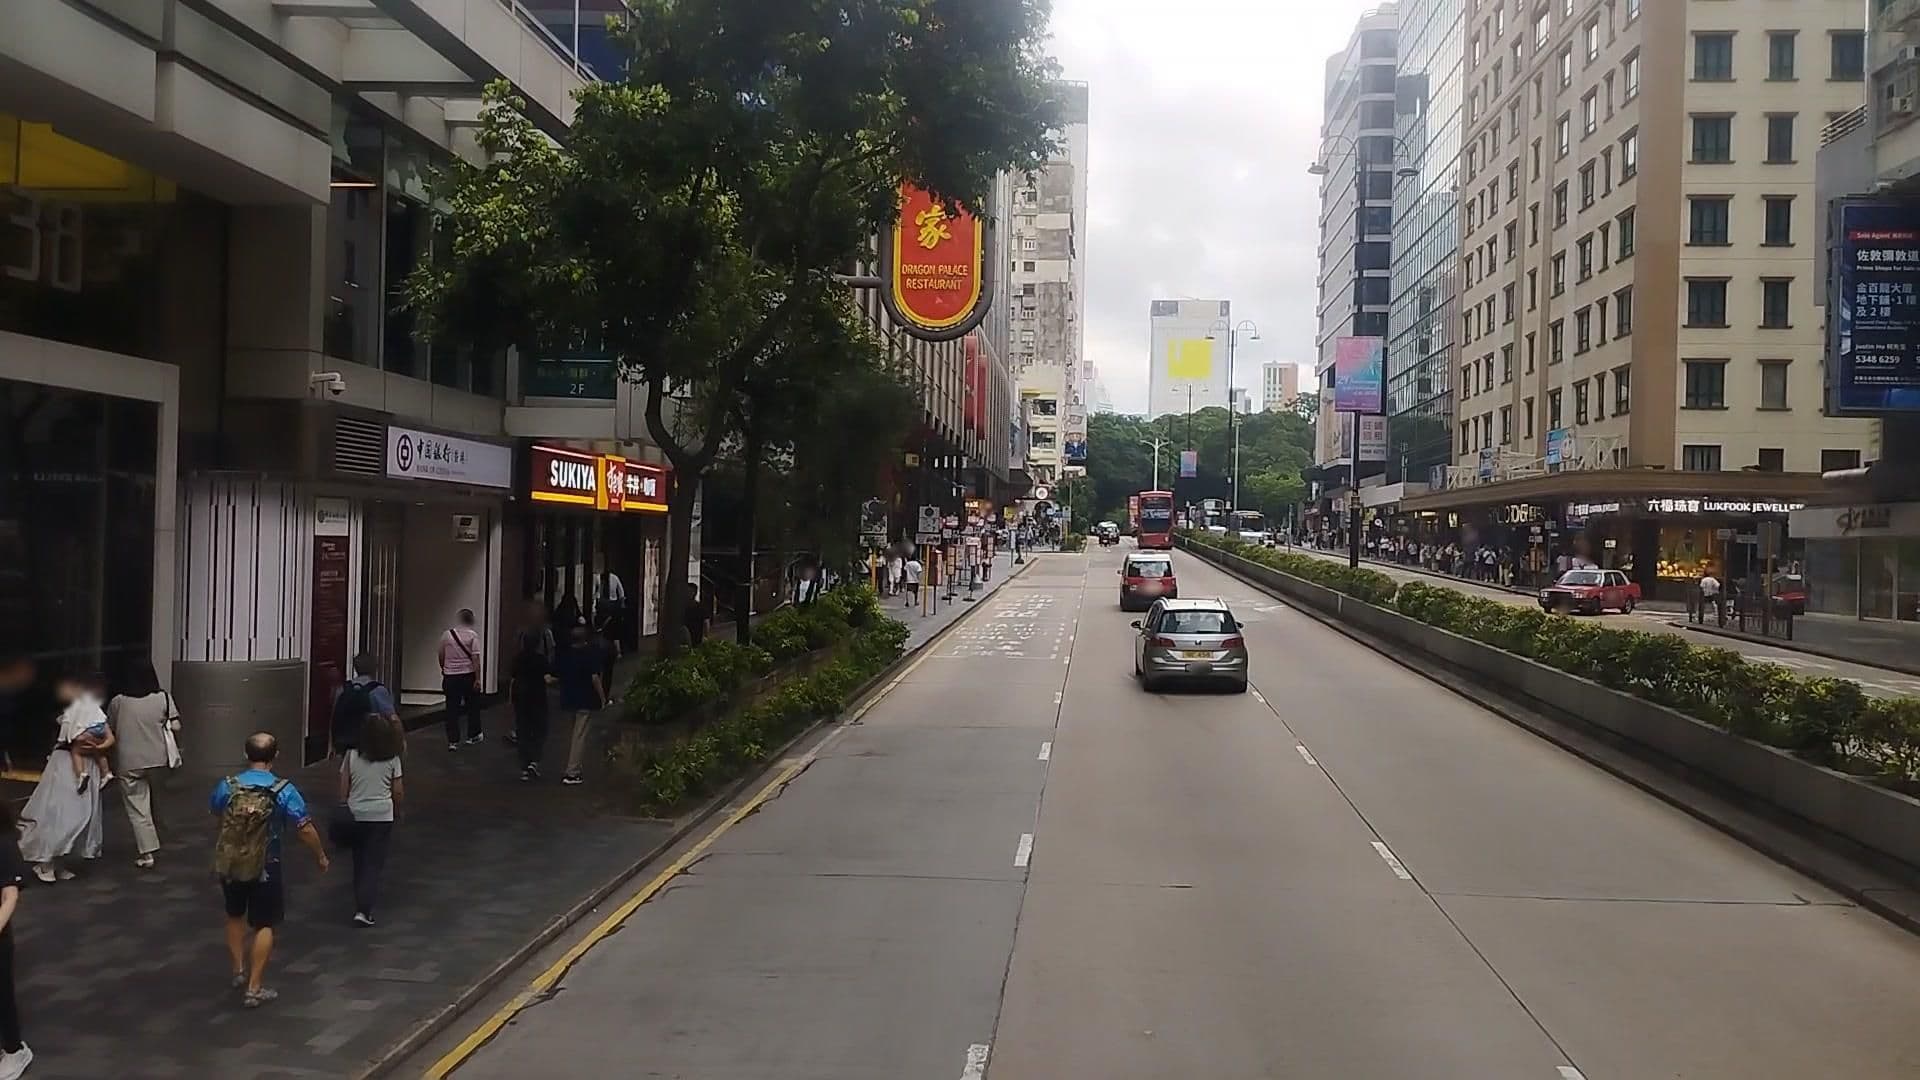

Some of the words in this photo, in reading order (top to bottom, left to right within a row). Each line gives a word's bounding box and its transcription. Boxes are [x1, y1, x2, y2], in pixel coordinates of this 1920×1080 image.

[916, 204, 952, 250] 家
[902, 264, 935, 275] DRAGON
[938, 264, 968, 276] PALACE
[906, 278, 962, 290] RESTAURANT
[1856, 355, 1877, 363] 5348
[1879, 355, 1900, 364] 6259
[569, 384, 585, 395] 2F
[550, 460, 596, 491] SUKIYA
[1648, 499, 1700, 512] 六福珠寶
[1704, 501, 1750, 511] LUKFOOK
